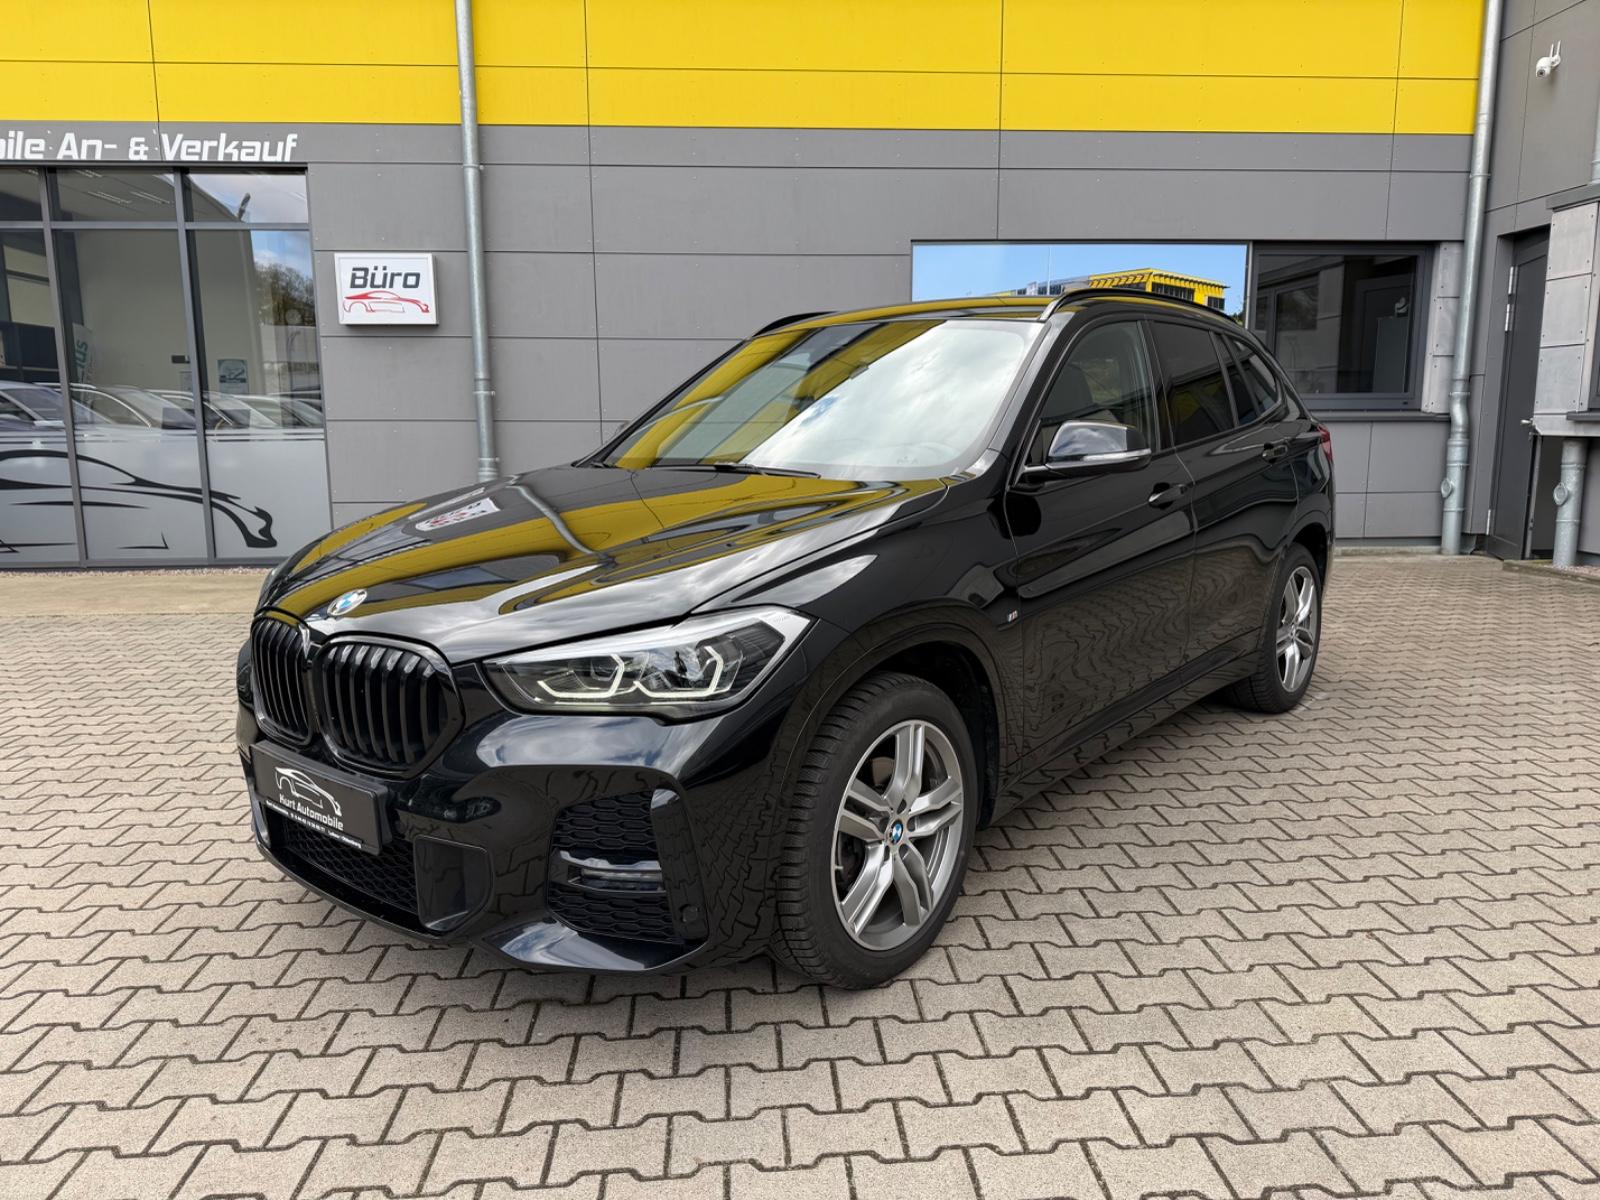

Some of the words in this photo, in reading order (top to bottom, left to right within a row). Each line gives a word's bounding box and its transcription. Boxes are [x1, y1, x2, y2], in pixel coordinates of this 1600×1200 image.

[0, 130, 45, 160] ile
[56, 132, 117, 160] An-
[128, 137, 148, 161] &
[162, 133, 298, 162] Verkauf
[350, 265, 421, 289] Büro
[297, 802, 344, 831] Automobile
